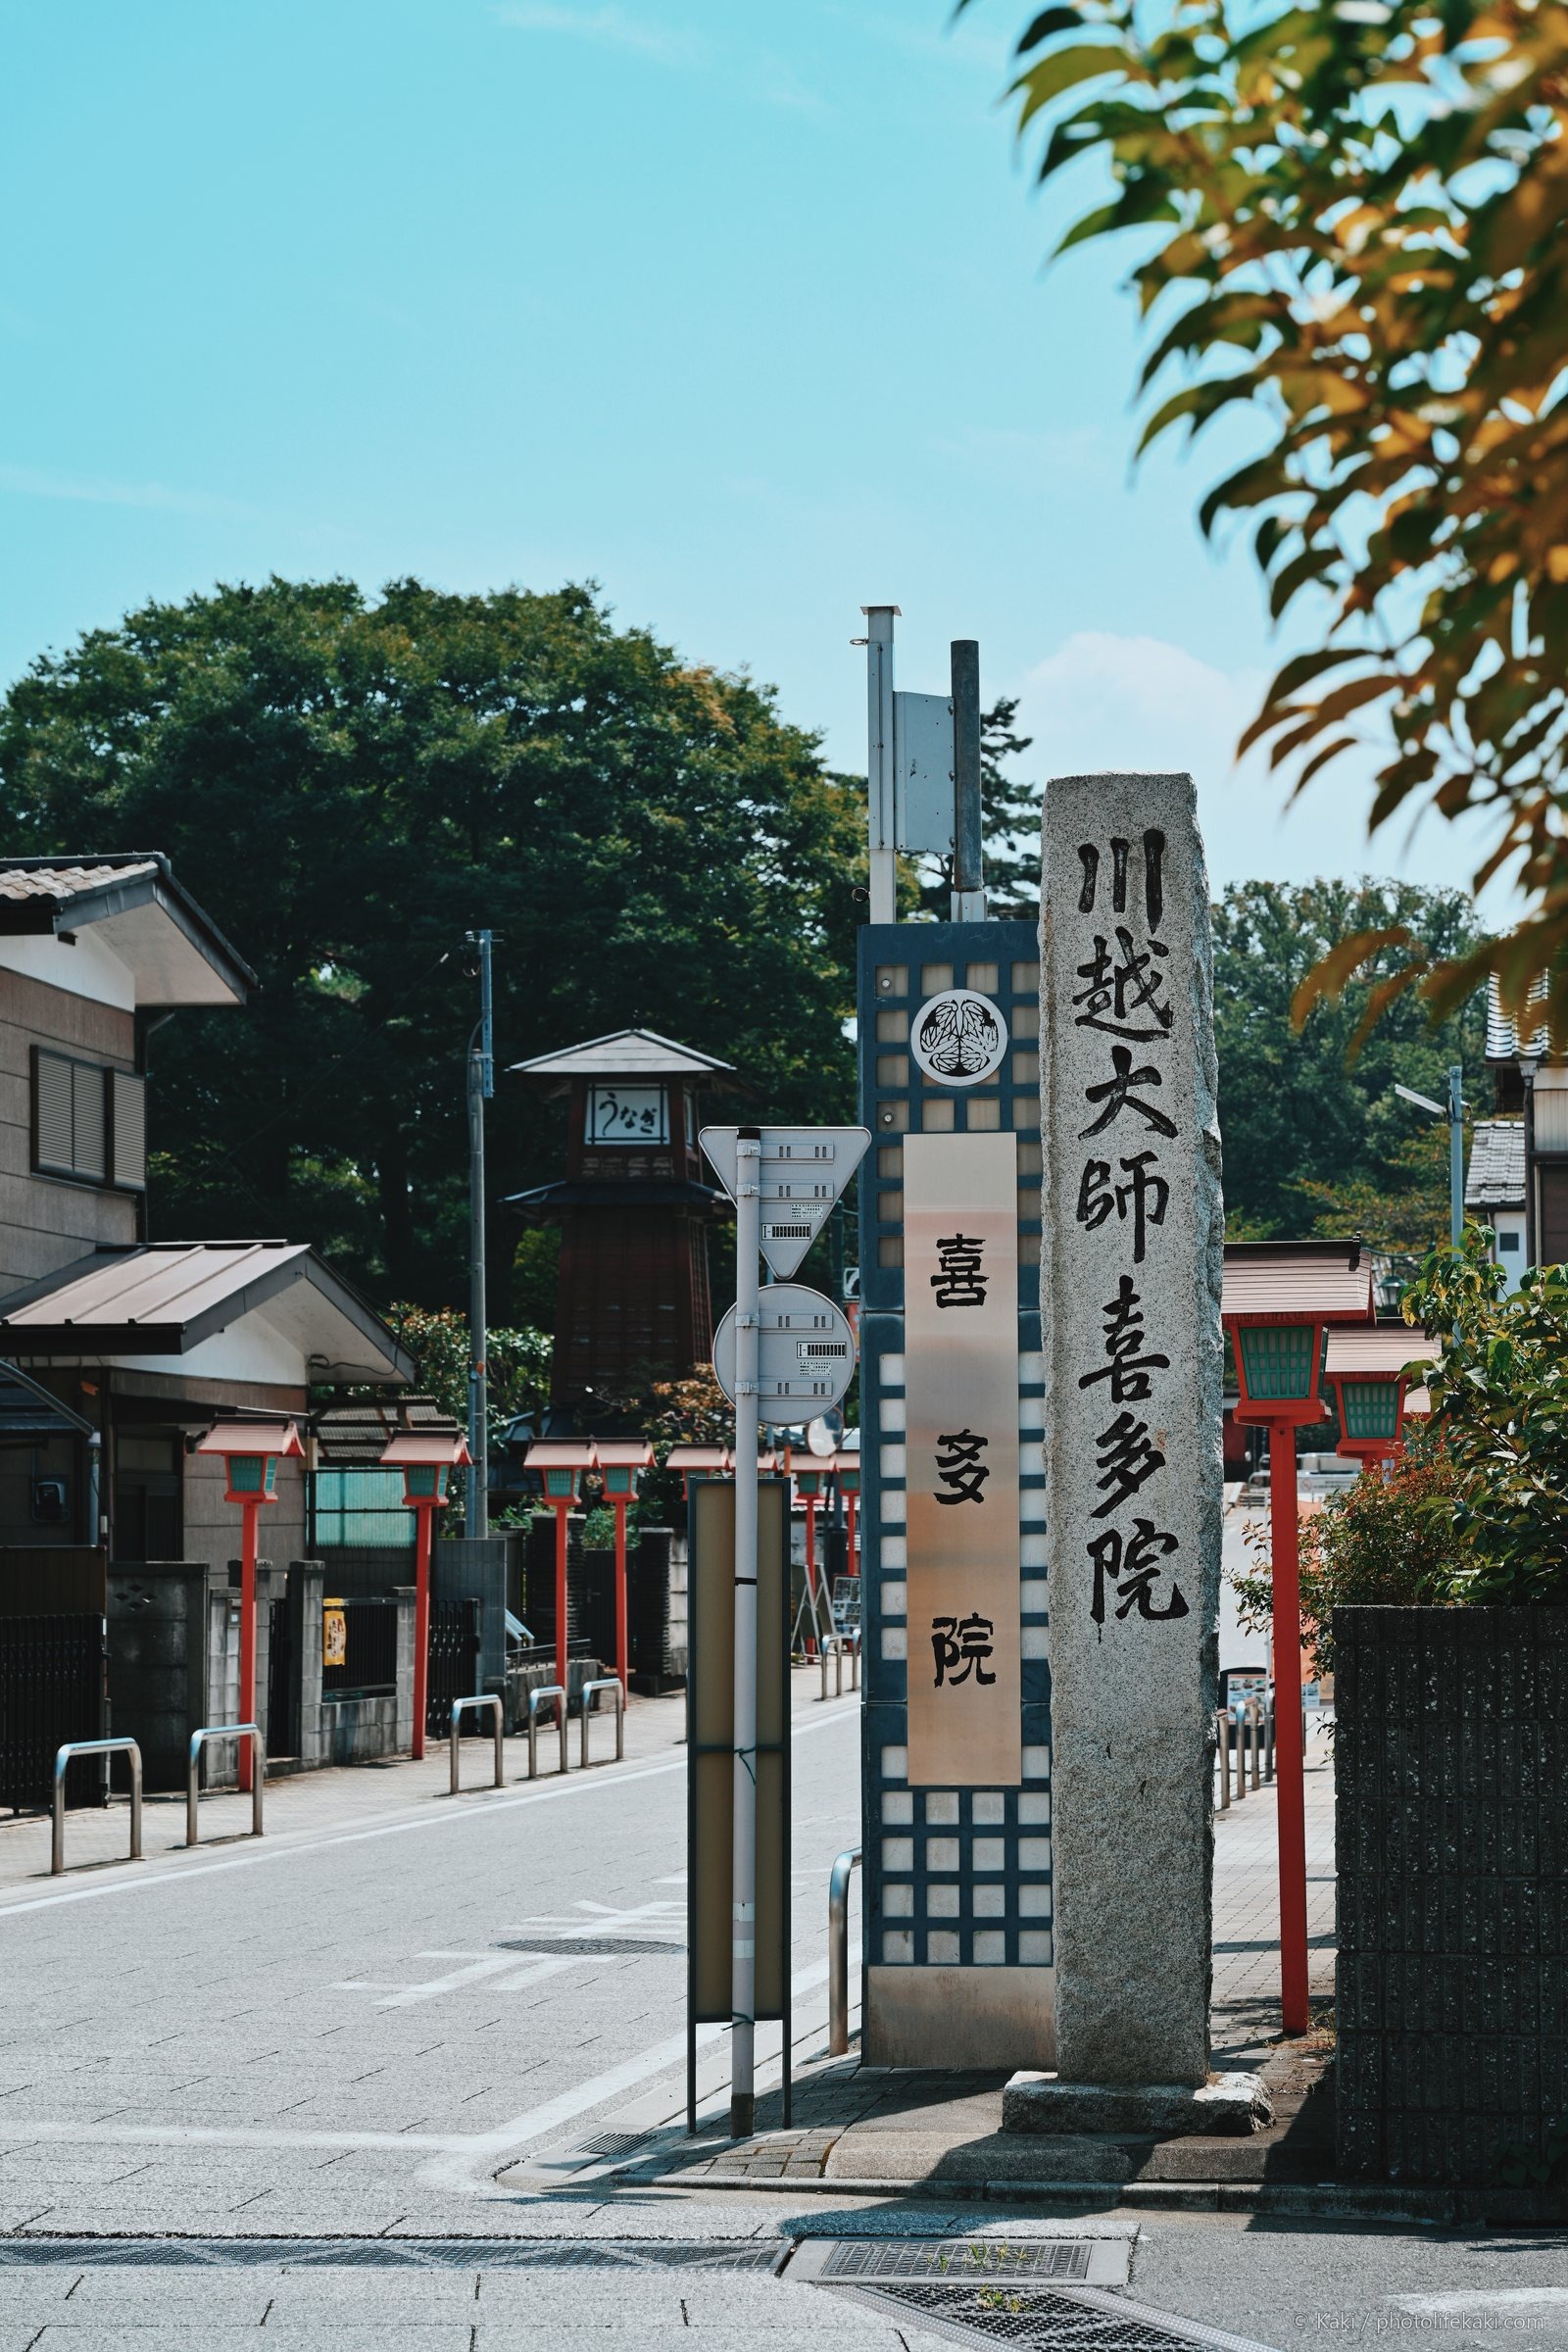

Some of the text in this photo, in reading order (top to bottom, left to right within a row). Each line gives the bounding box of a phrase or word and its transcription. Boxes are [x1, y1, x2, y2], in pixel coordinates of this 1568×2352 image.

[599, 1091, 658, 1136] うなぎ
[1071, 827, 1189, 1623] 川越大師喜多院
[930, 1233, 997, 1689] 喜多院
